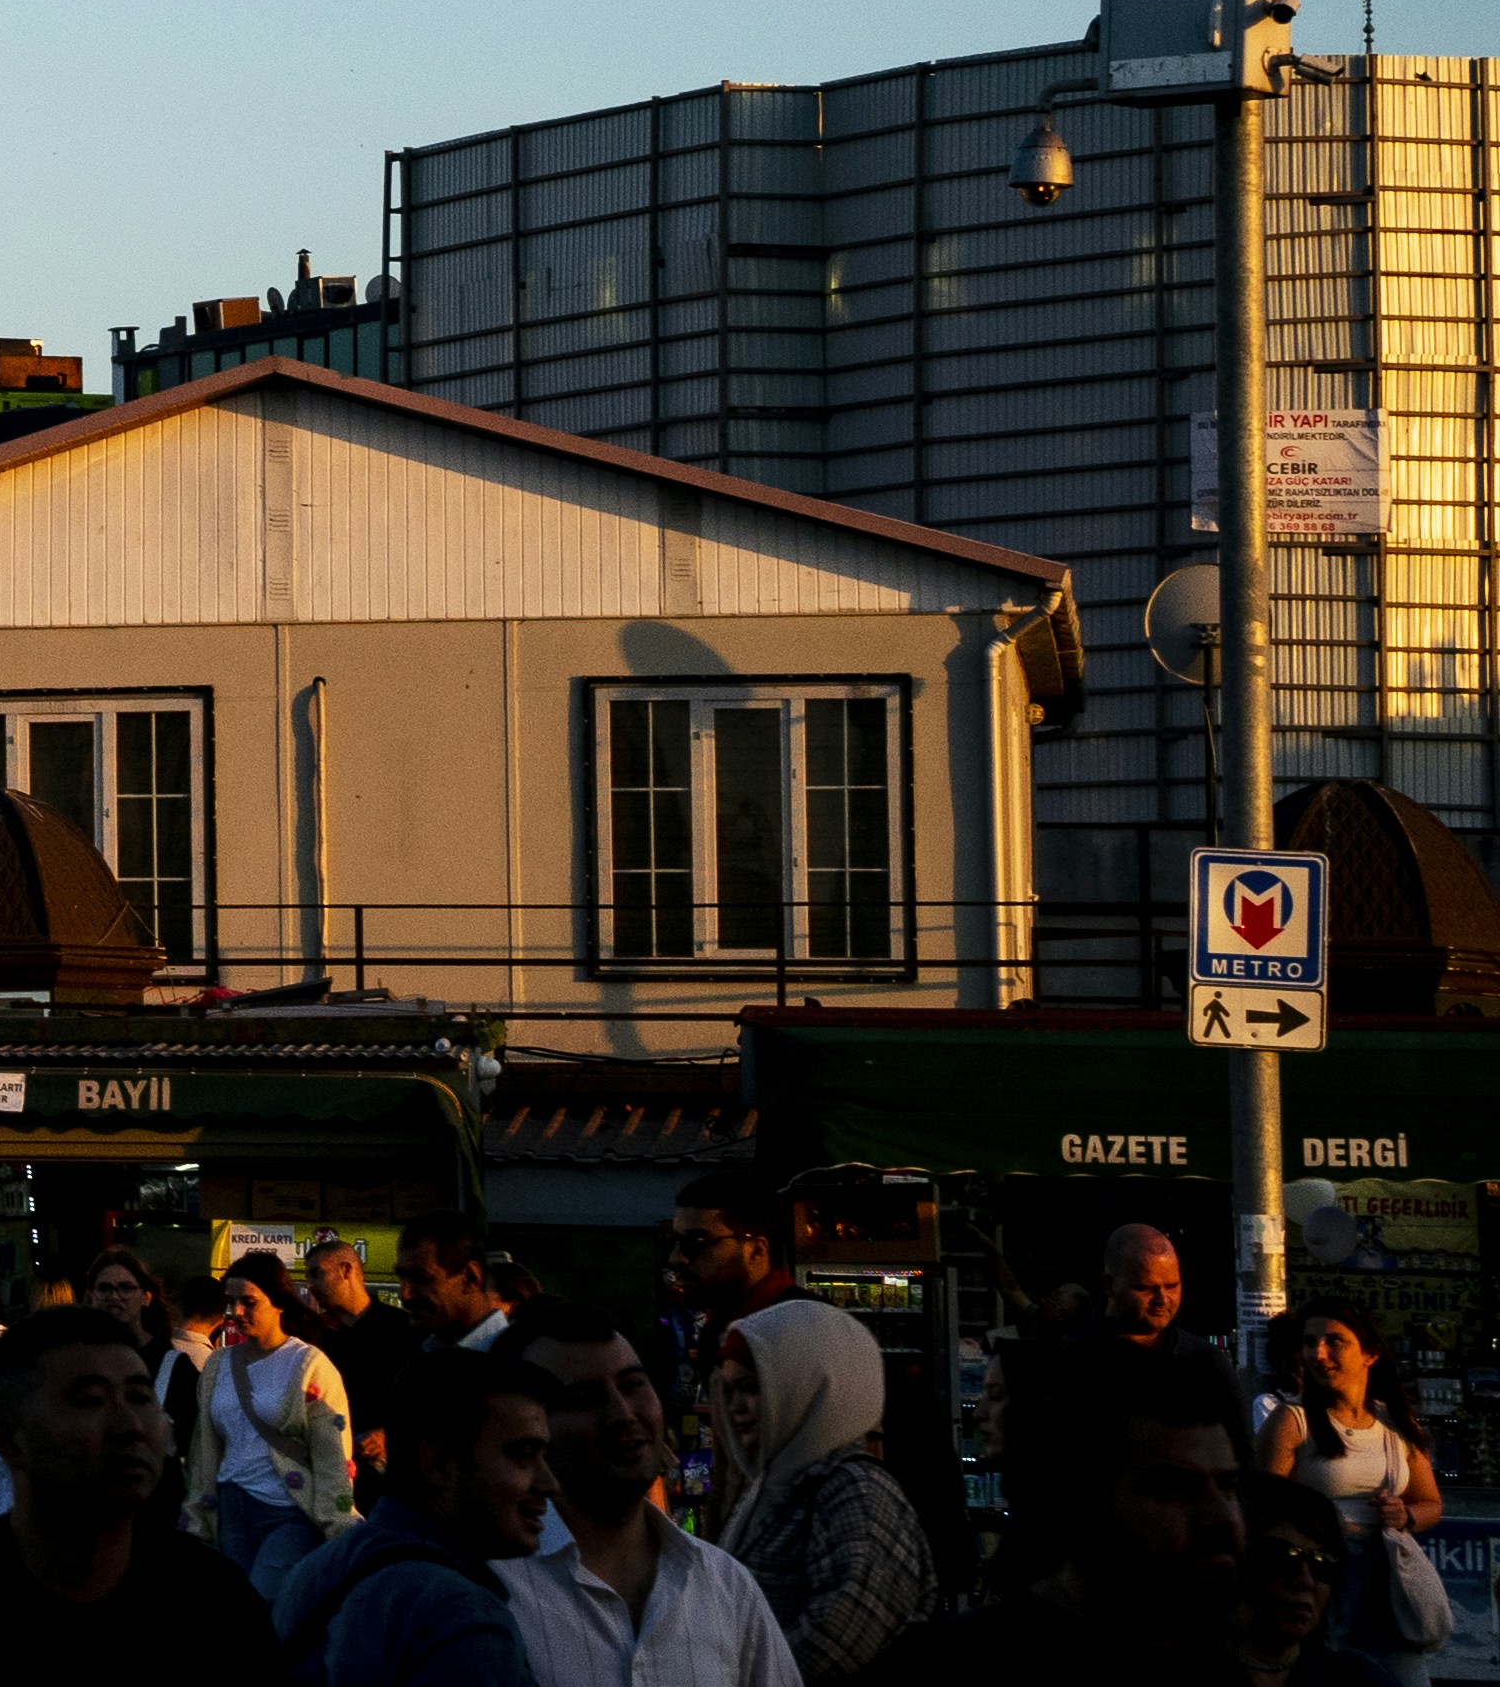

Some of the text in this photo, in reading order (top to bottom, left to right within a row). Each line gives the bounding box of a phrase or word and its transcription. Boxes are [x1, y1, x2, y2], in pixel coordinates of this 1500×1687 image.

[1290, 414, 1328, 428] YAPI
[1286, 476, 1352, 486] GÜÇ KATAR!
[1212, 958, 1303, 979] METRO
[78, 1076, 171, 1111] BAYİİ
[1061, 1132, 1408, 1167] GAZETE DERGİ
[231, 1232, 293, 1244] KREDİ KARTI
